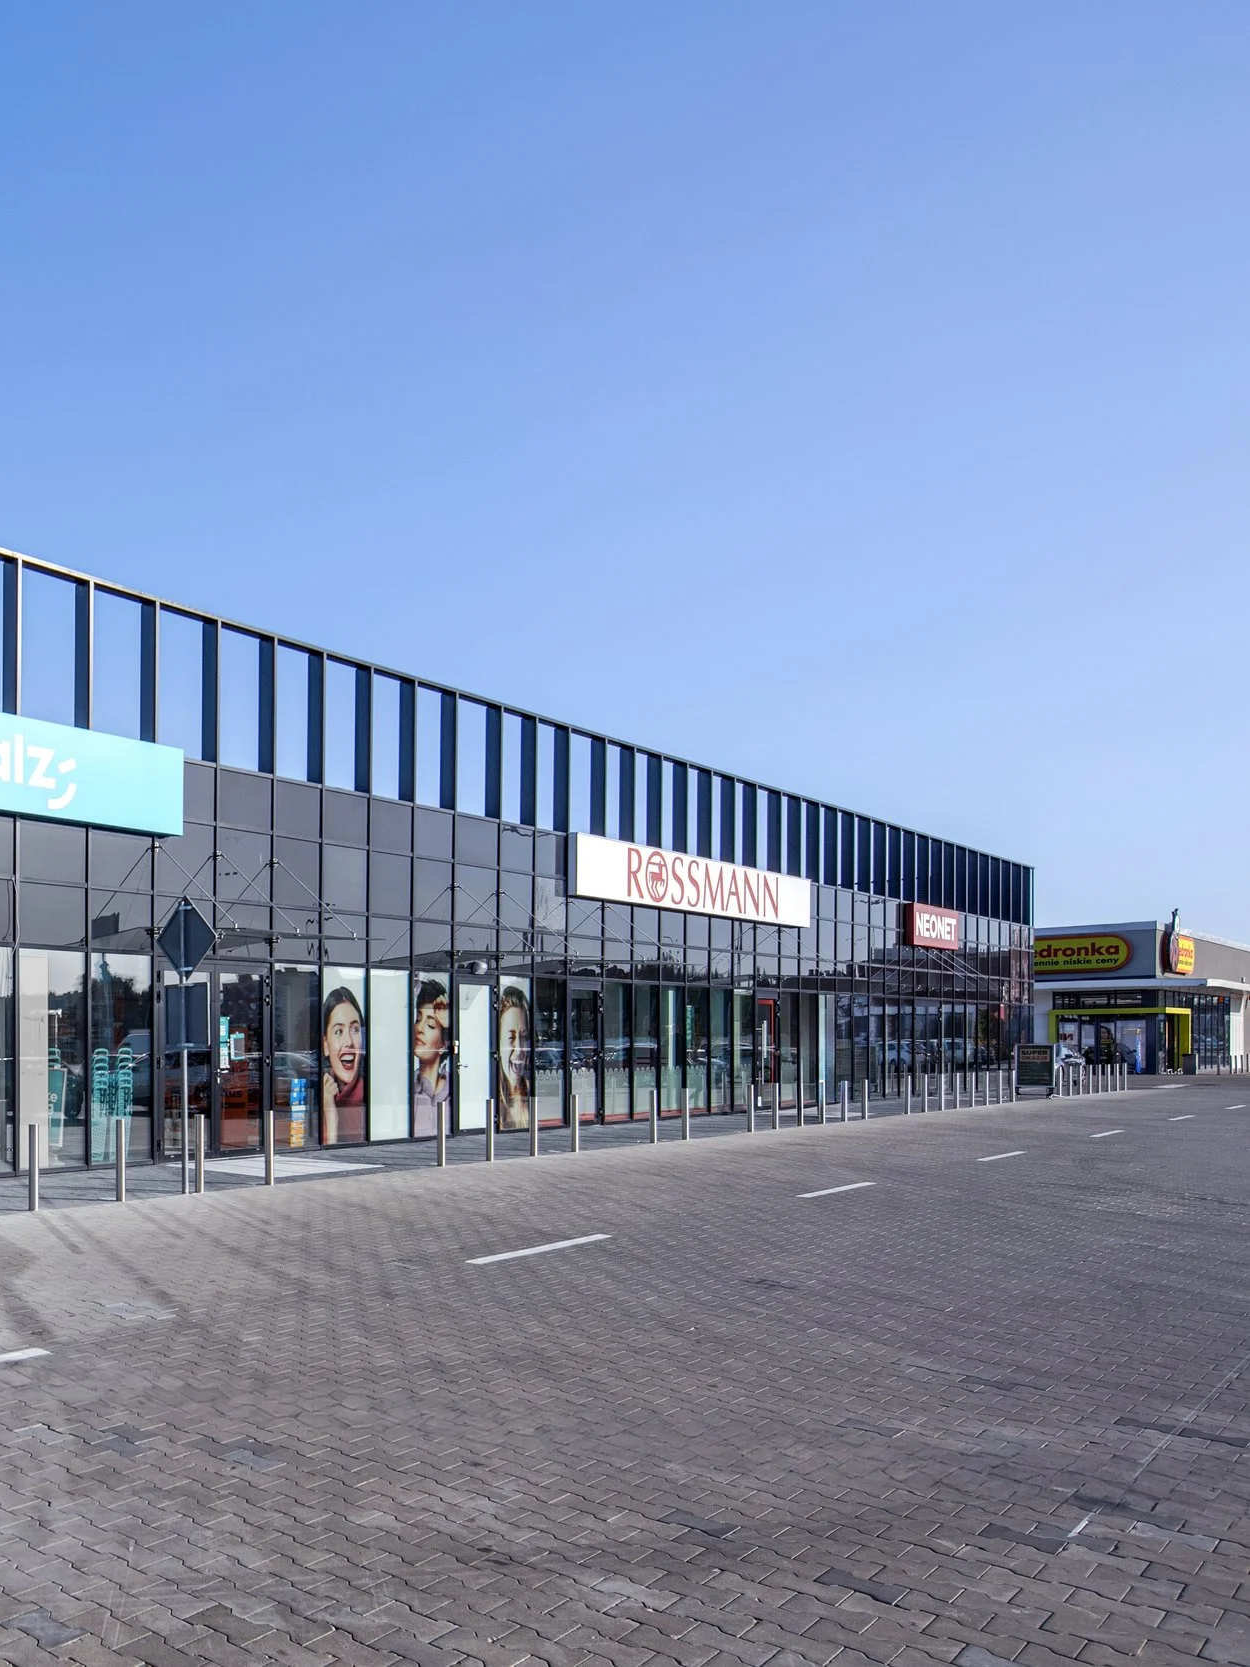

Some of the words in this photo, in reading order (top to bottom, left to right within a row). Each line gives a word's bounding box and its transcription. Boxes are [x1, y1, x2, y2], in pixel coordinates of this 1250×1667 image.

[626, 847, 779, 919] ROSSMANN
[915, 911, 957, 941] NEONET
[1034, 942, 1119, 959] dronka
[1063, 957, 1092, 965] niskie
[1095, 957, 1119, 965] ceny
